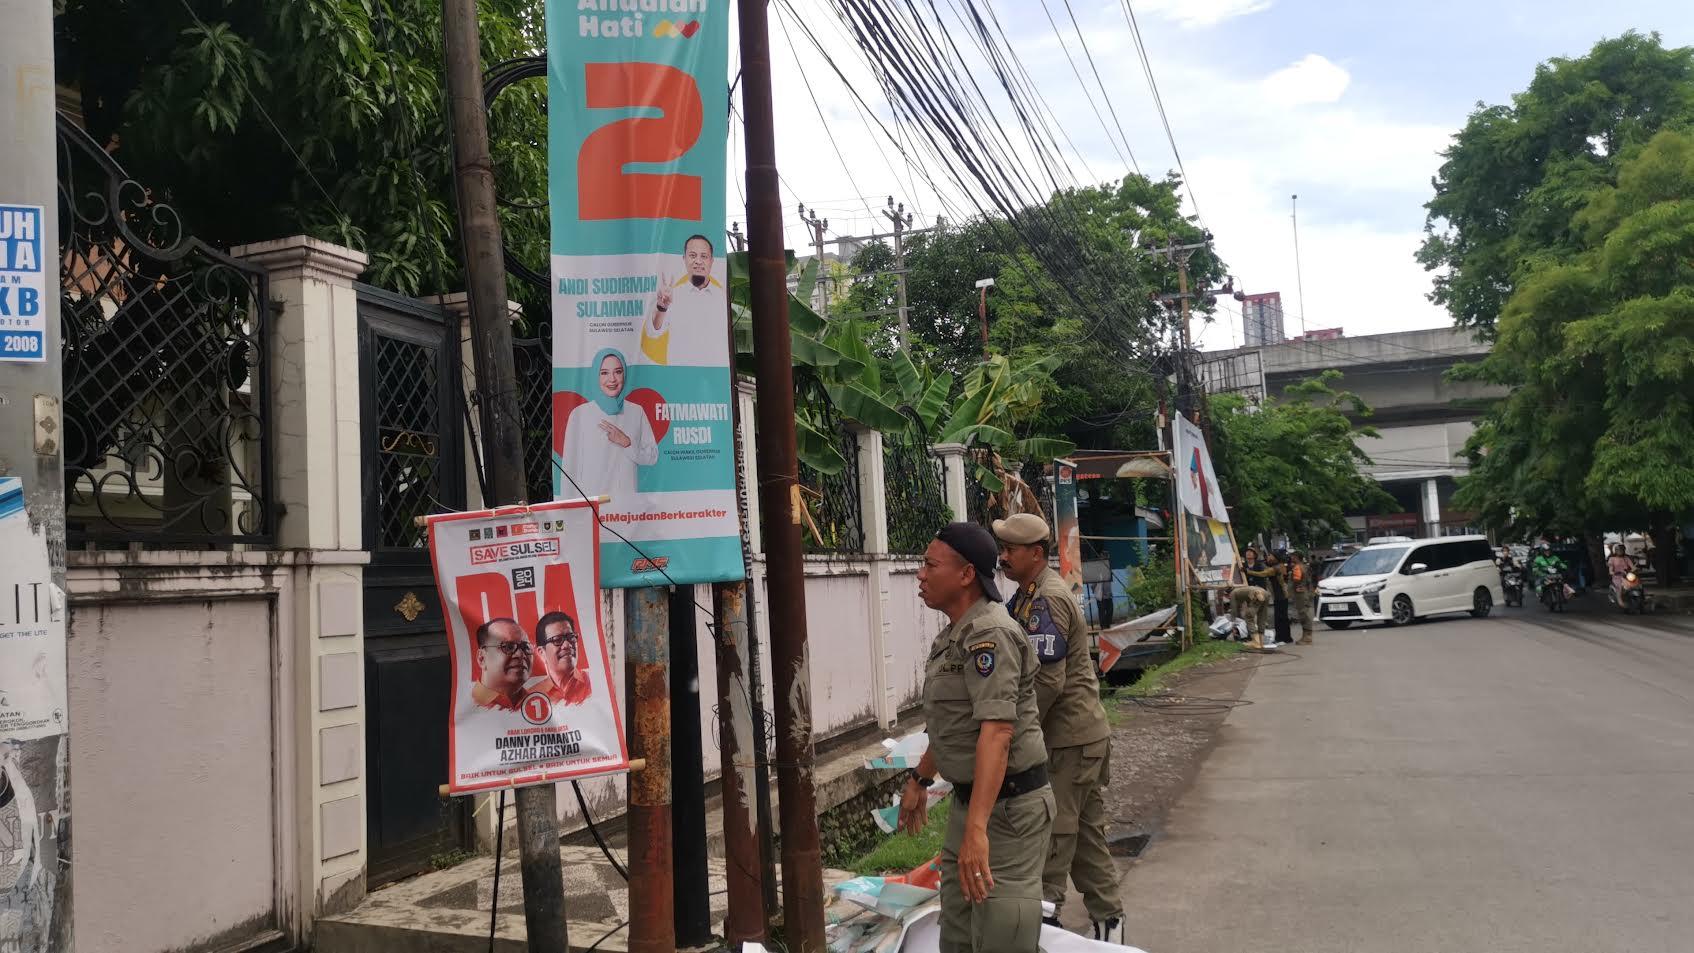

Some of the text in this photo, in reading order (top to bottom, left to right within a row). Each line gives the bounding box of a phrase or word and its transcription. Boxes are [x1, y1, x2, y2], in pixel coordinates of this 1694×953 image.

[578, 12, 643, 38] Hati
[577, 62, 704, 222] 2
[558, 275, 658, 295] ANDI SUDIRMAN
[576, 300, 644, 318] SULAIMAN
[4, 336, 39, 353] 2008
[655, 403, 729, 422] FATMAWATI
[673, 426, 712, 445] RUSDI
[474, 545, 509, 561] SAVE
[510, 541, 556, 556] SULSEL
[530, 698, 542, 719] 1
[495, 730, 582, 750] DANNY POMANTO
[500, 747, 537, 762] AZHAR
[539, 742, 580, 758] ARSYAD
[460, 771, 481, 780] BAIK
[481, 769, 508, 778] UNTUK
[508, 764, 539, 776] SULSEL
[545, 760, 565, 770] BAIK
[565, 758, 592, 768] UNTUK
[592, 754, 618, 764] SEMUA
